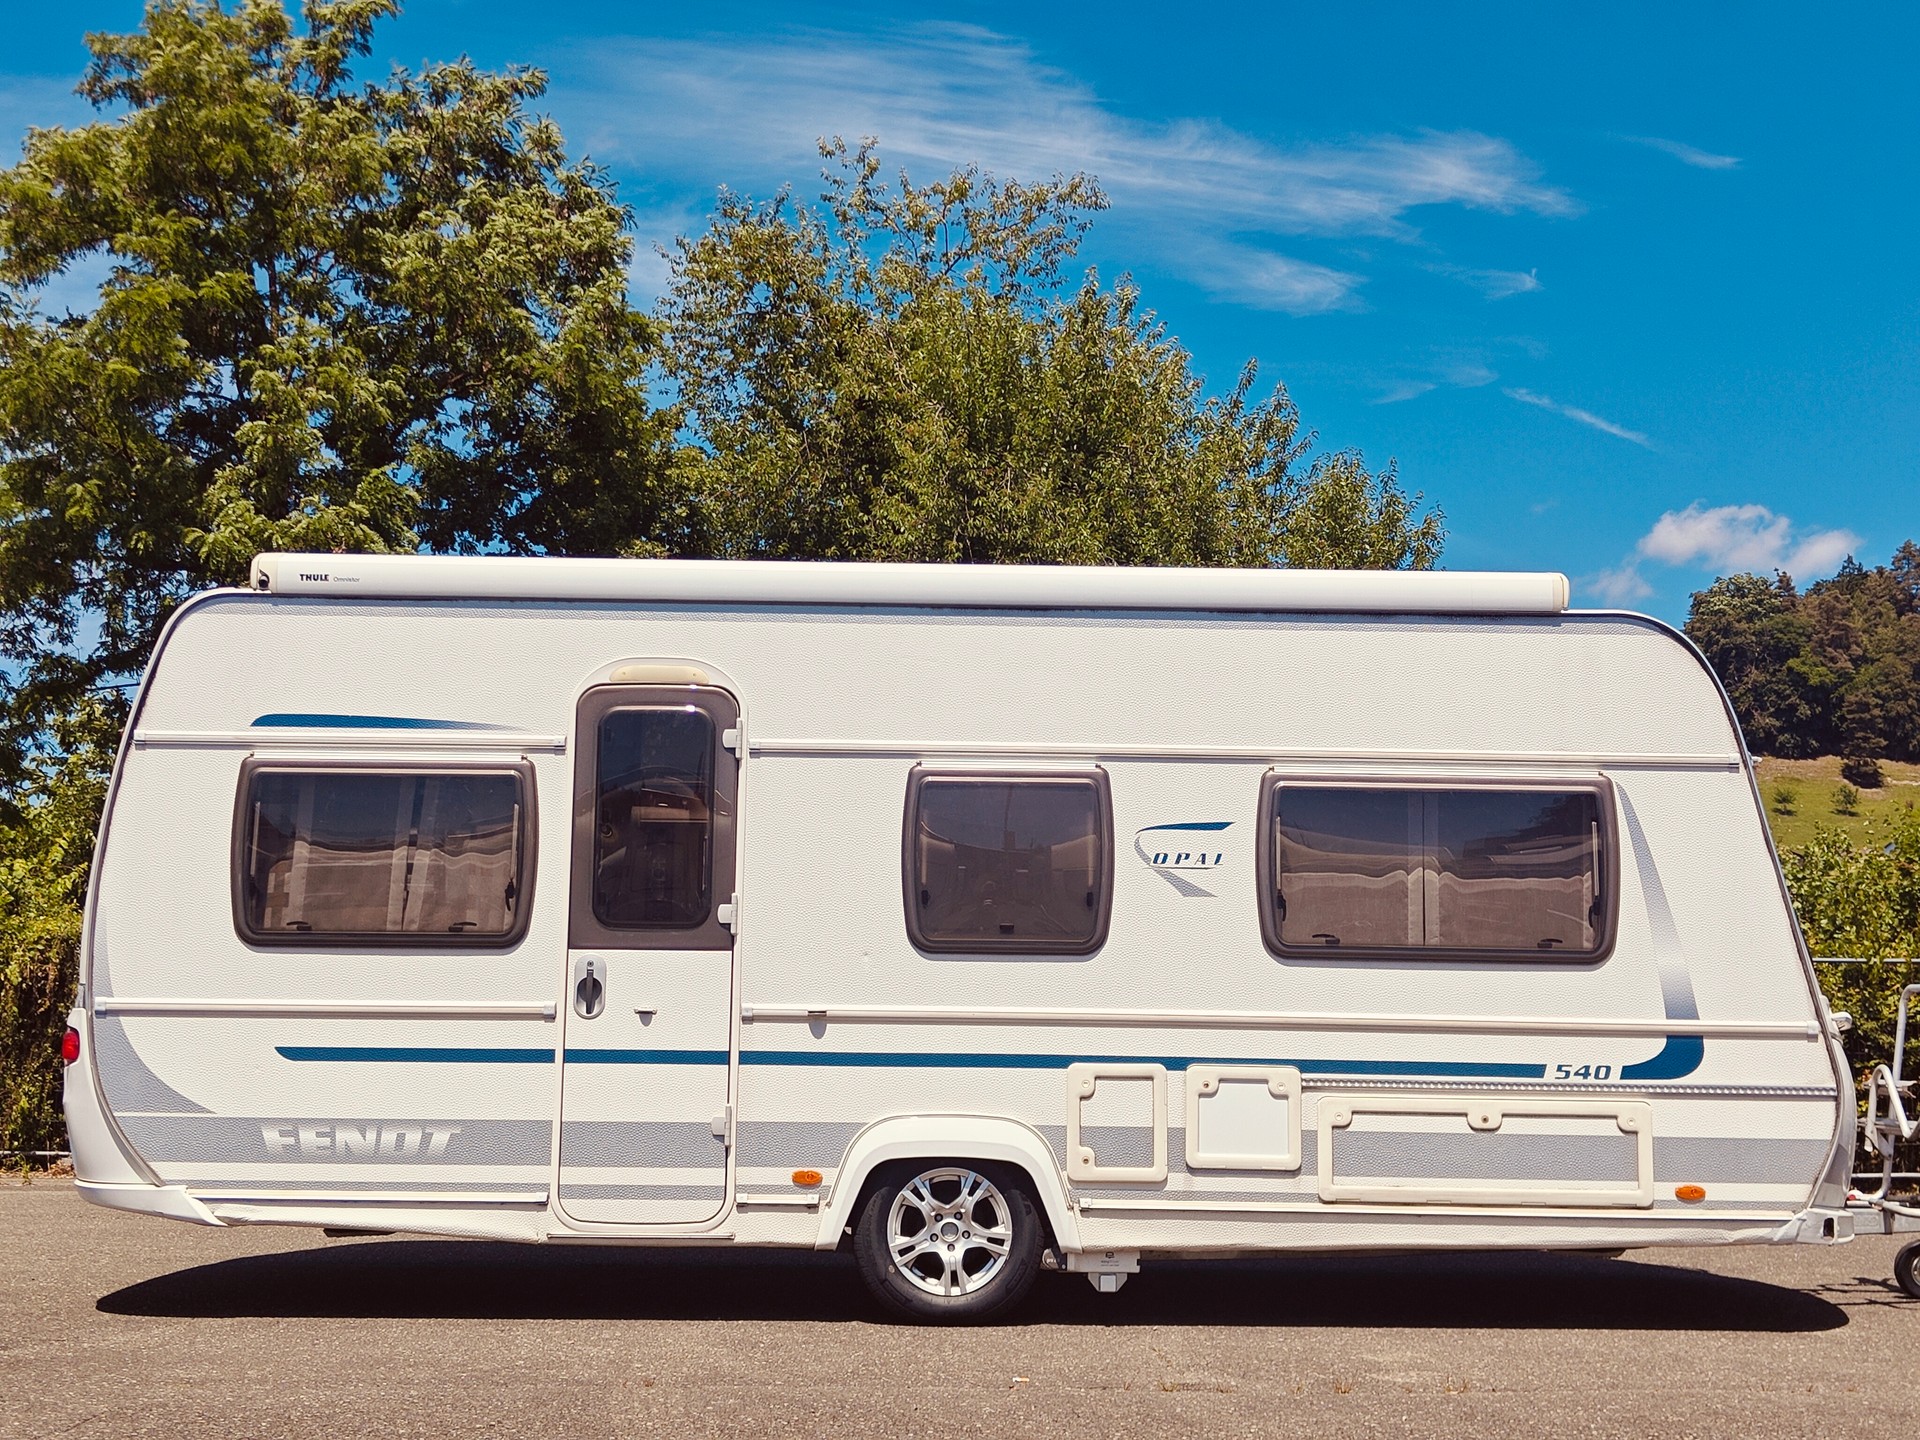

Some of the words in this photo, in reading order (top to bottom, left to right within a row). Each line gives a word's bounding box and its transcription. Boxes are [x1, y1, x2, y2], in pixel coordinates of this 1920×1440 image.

[299, 573, 330, 582] THULE
[1152, 852, 1224, 866] OPAL
[1554, 1064, 1612, 1080] 540
[260, 1124, 463, 1156] FENDT
